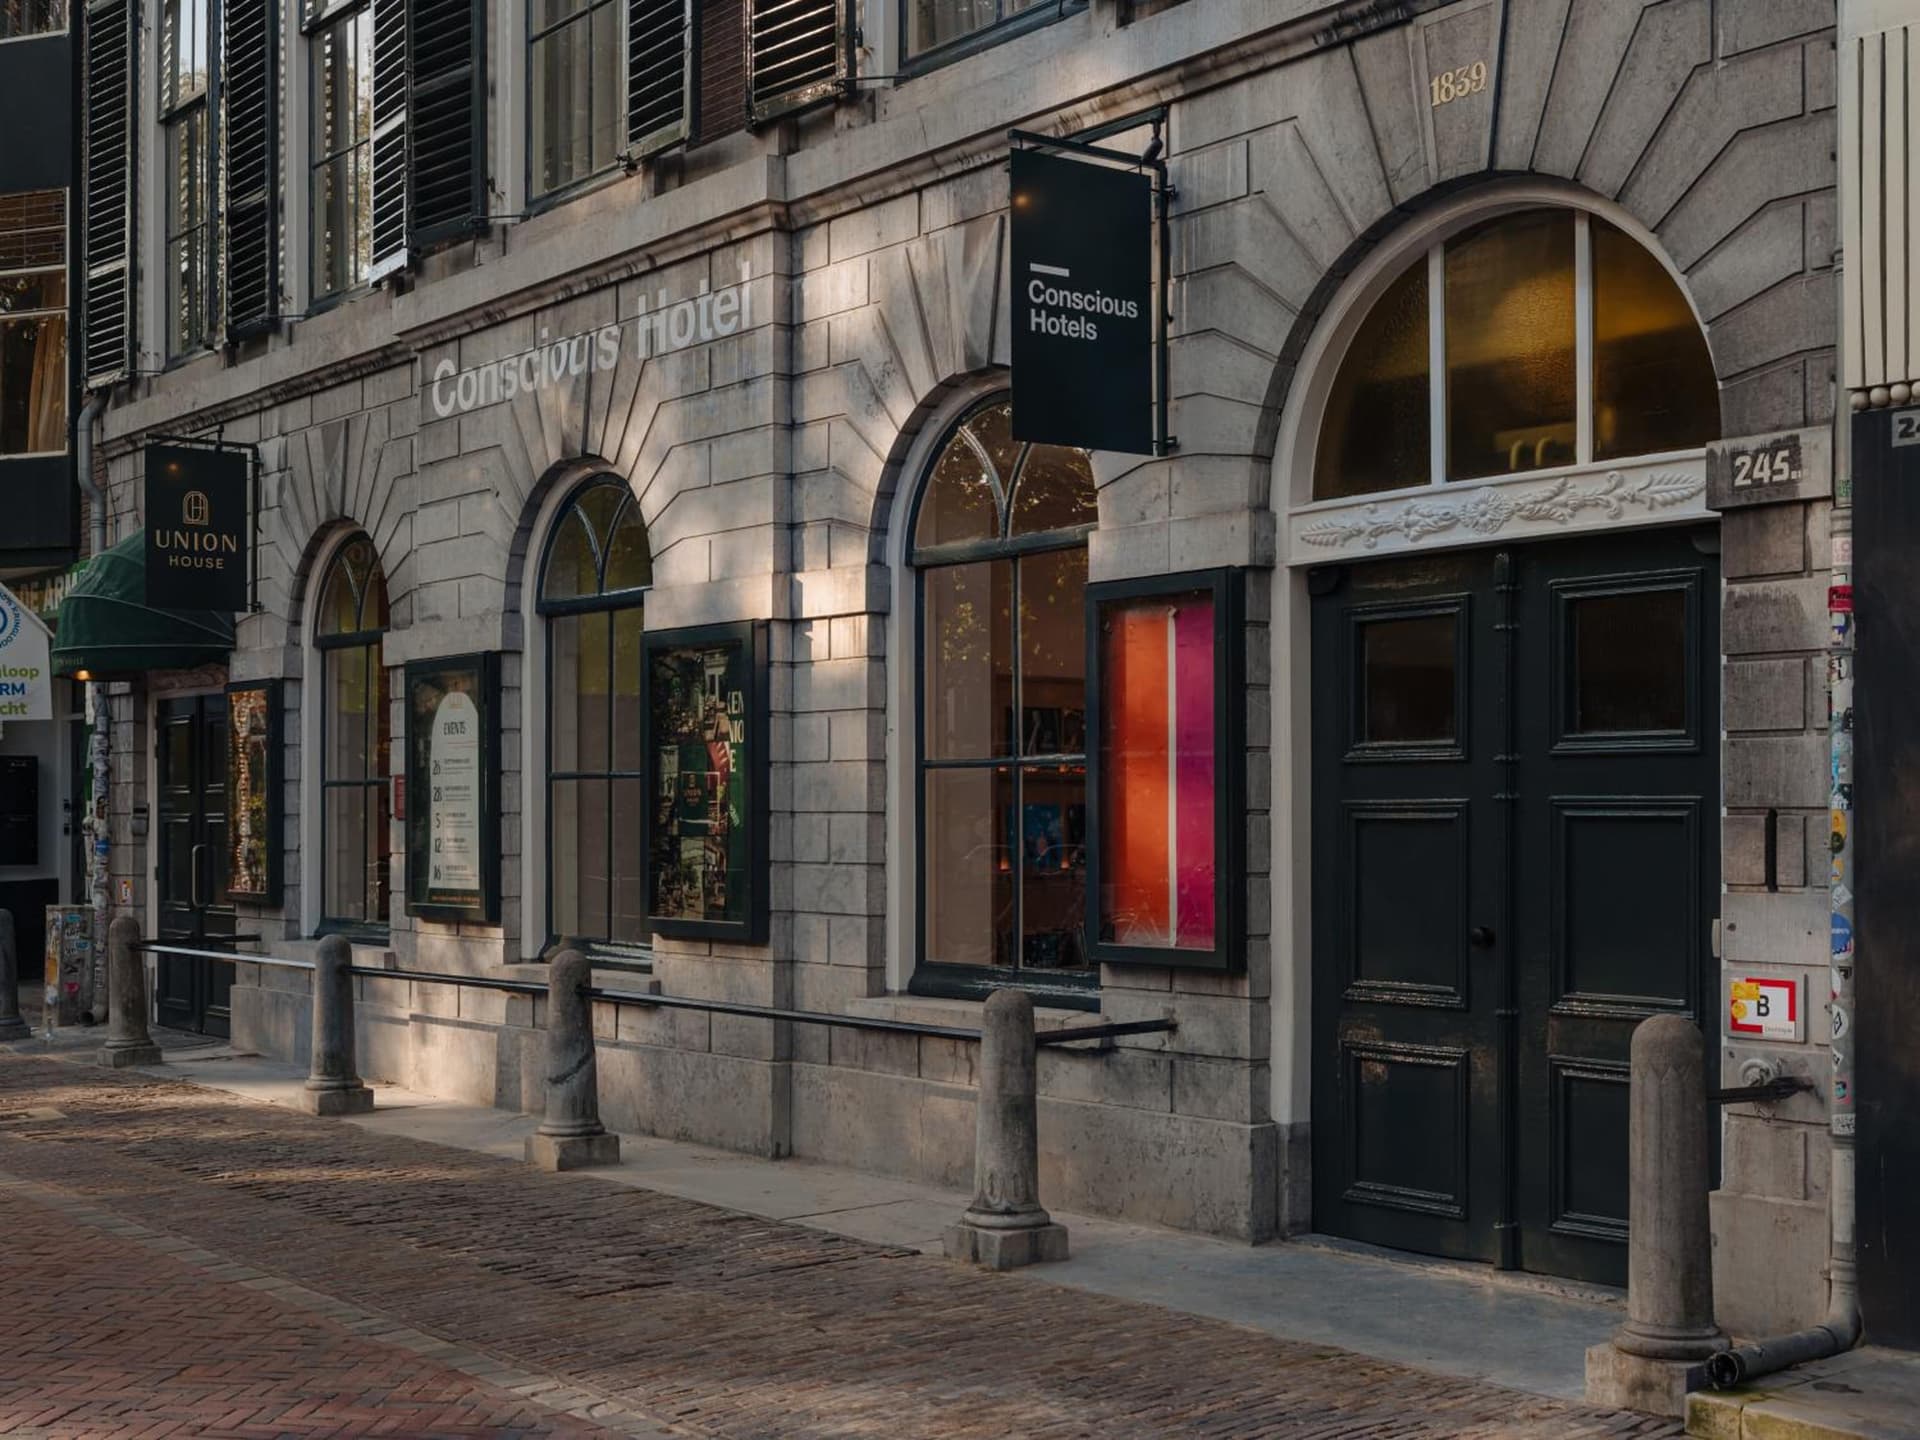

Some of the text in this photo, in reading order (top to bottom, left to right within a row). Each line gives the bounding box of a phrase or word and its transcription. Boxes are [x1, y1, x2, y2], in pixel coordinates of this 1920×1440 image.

[1430, 61, 1487, 107] 1839
[1028, 279, 1139, 318] Conscious
[1030, 308, 1098, 341] Hotels
[432, 258, 751, 417] Conscious Hotel
[1898, 416, 1920, 439] 2
[155, 529, 237, 553] UNION
[169, 555, 225, 569] HOUSE
[0, 664, 40, 680] loop
[1756, 995, 1770, 1017] B
